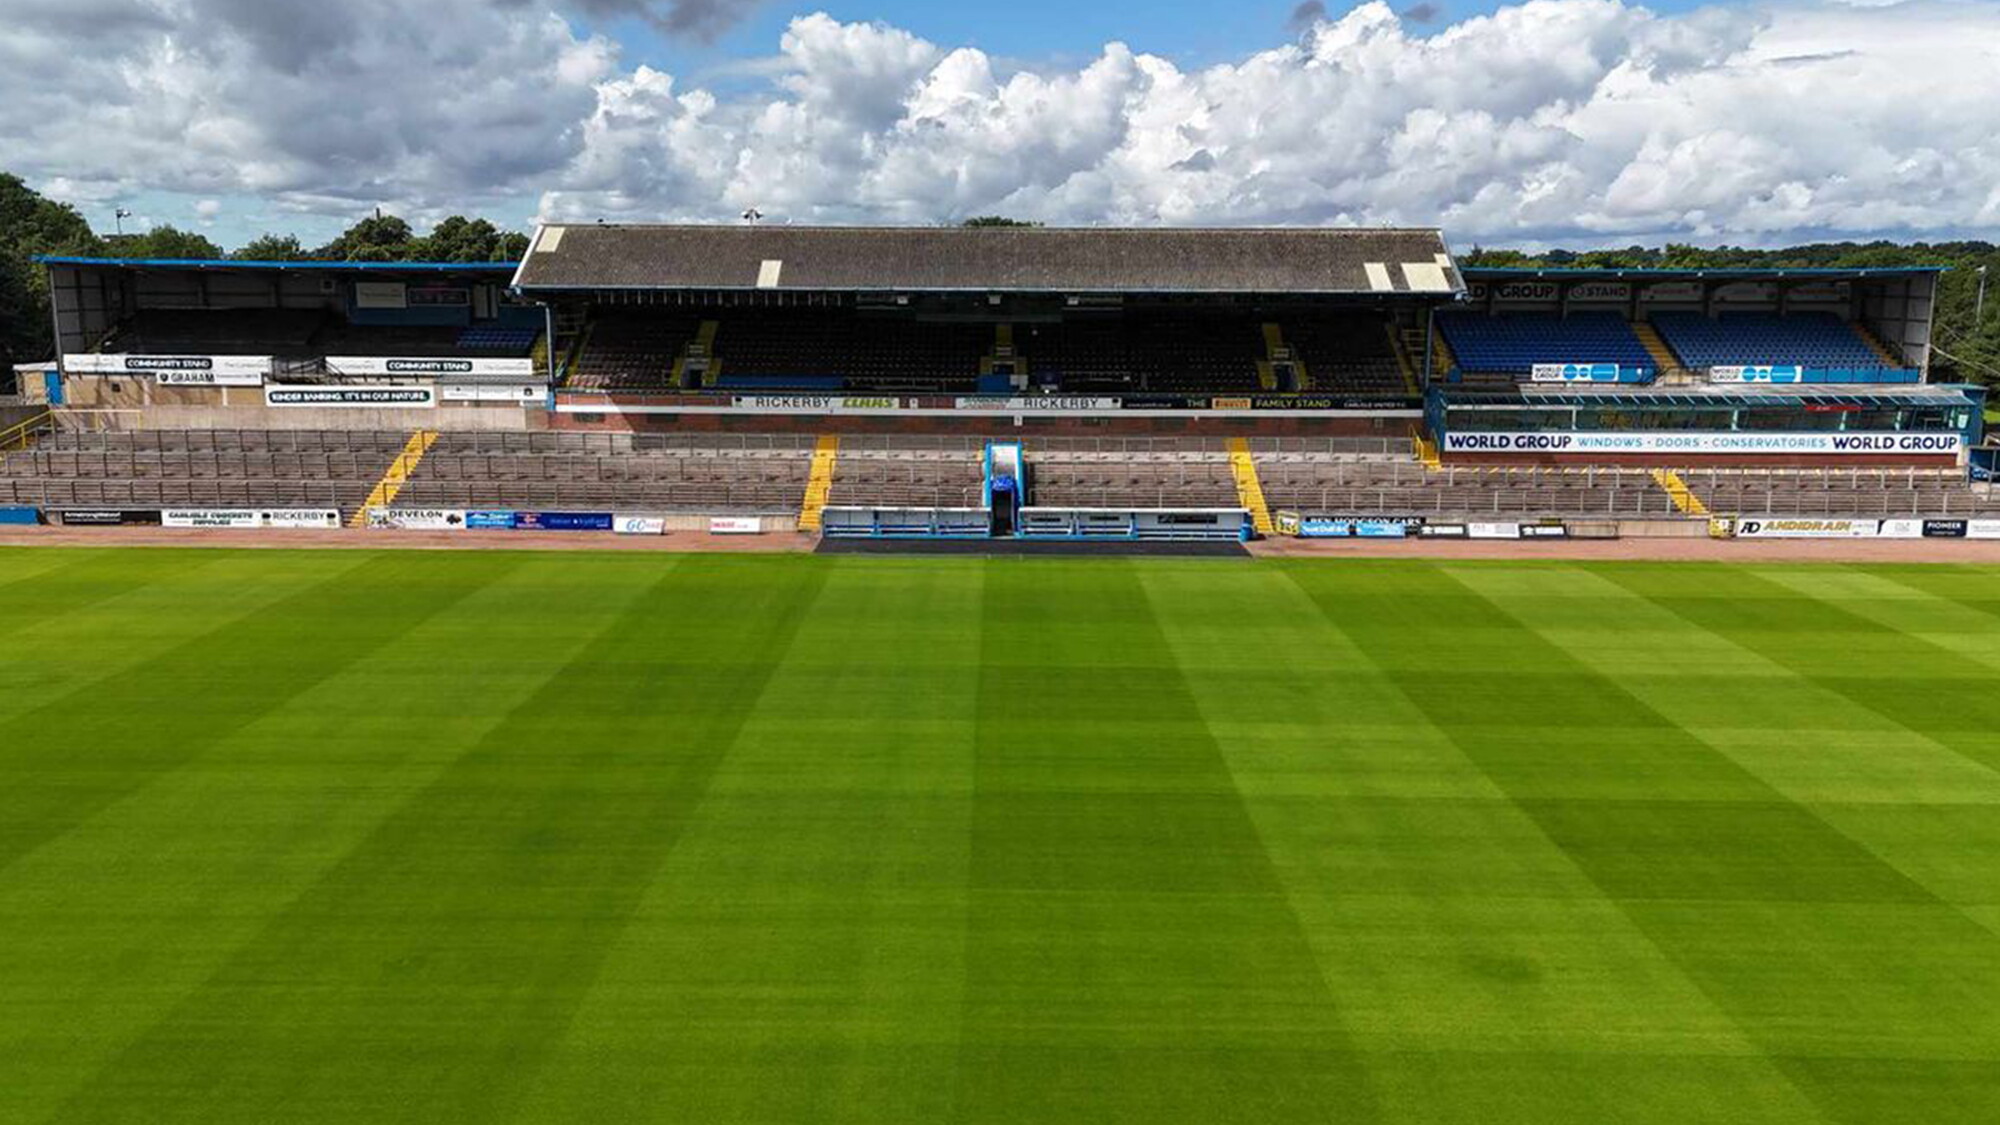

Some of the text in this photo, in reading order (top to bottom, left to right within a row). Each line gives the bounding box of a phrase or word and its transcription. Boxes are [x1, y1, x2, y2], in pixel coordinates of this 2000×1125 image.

[1500, 284, 1627, 298] GROUP STAND
[127, 359, 210, 368] COMMUNITY STAND
[388, 361, 470, 370] COMMUNITY STAND
[171, 373, 214, 382] GRAHAM
[272, 393, 301, 401] KINDER
[755, 397, 831, 408] RICKERBY
[1023, 398, 1098, 409] RICKERBY
[1256, 400, 1293, 408] FAMILY
[1296, 400, 1331, 408] STAND
[1449, 435, 1958, 449] WORLD GROUP WINDOWS DOORS CONSERVATORIES WORLD GROUP
[273, 512, 325, 520] RICKERBY
[389, 510, 443, 518] DEVELON
[1927, 522, 1961, 530] PIONEER
